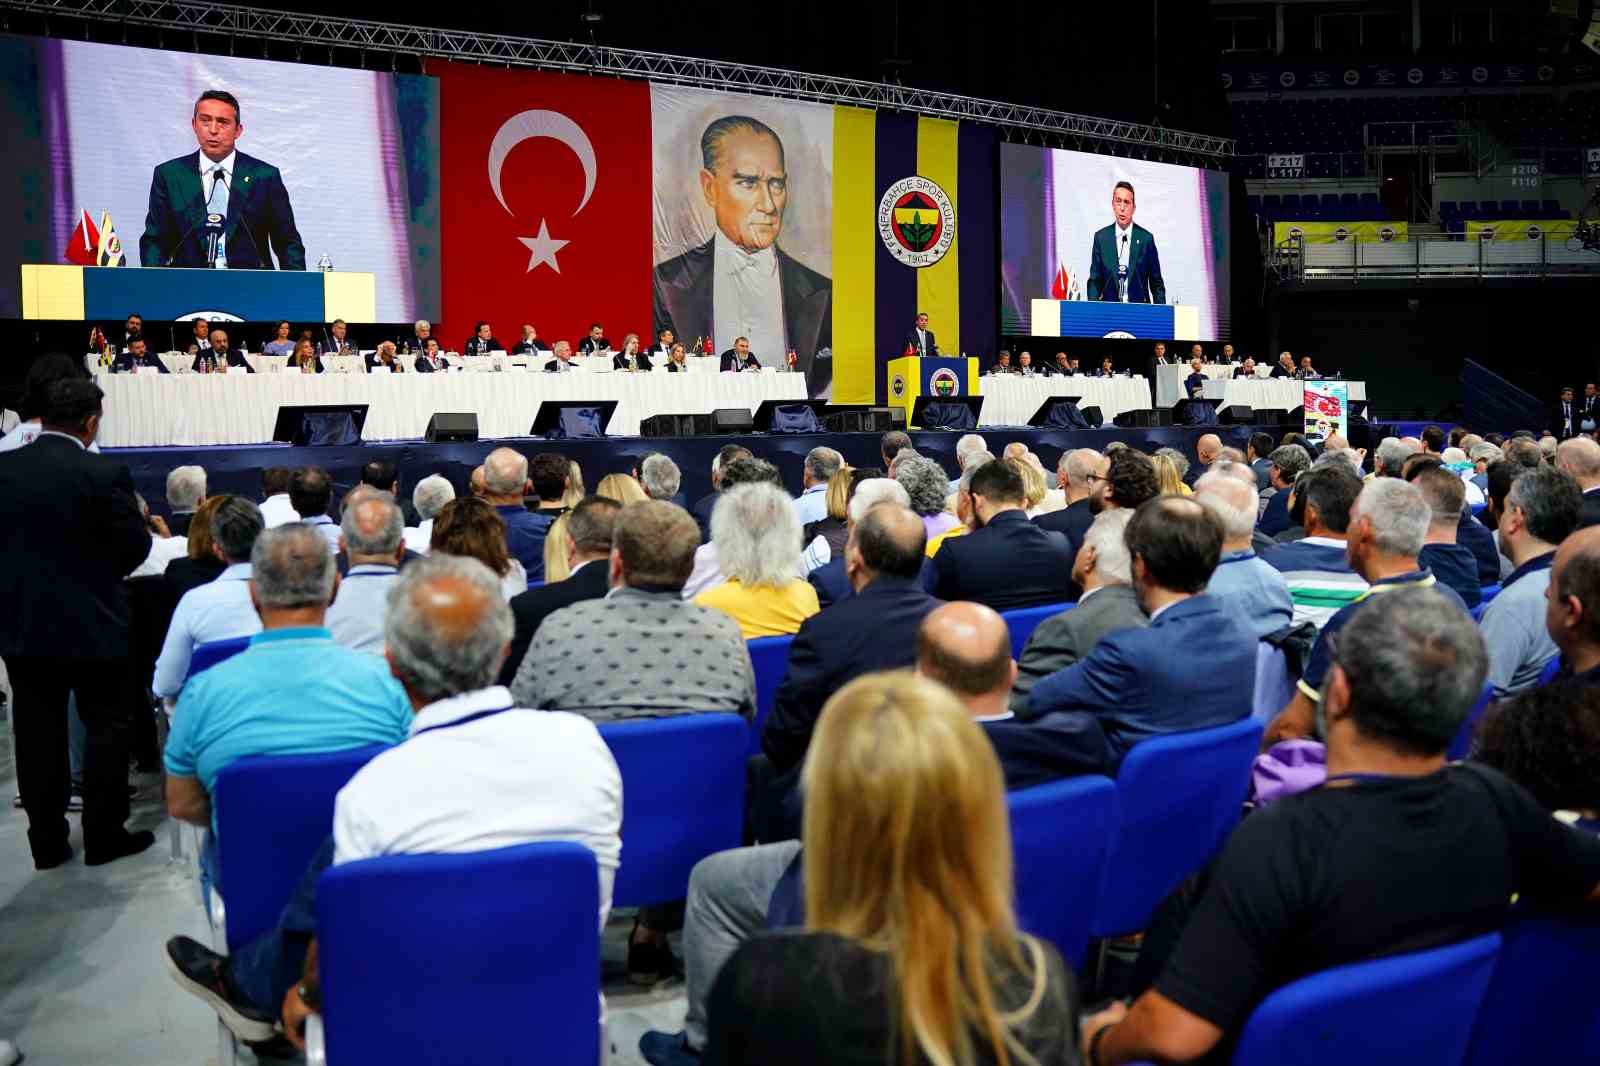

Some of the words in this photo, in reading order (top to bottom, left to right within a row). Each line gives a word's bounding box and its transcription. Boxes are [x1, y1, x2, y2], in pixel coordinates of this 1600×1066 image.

[1280, 157, 1301, 166] 217
[1280, 168, 1302, 177] 117
[916, 179, 943, 201] SPOR
[907, 254, 929, 264] 1907
